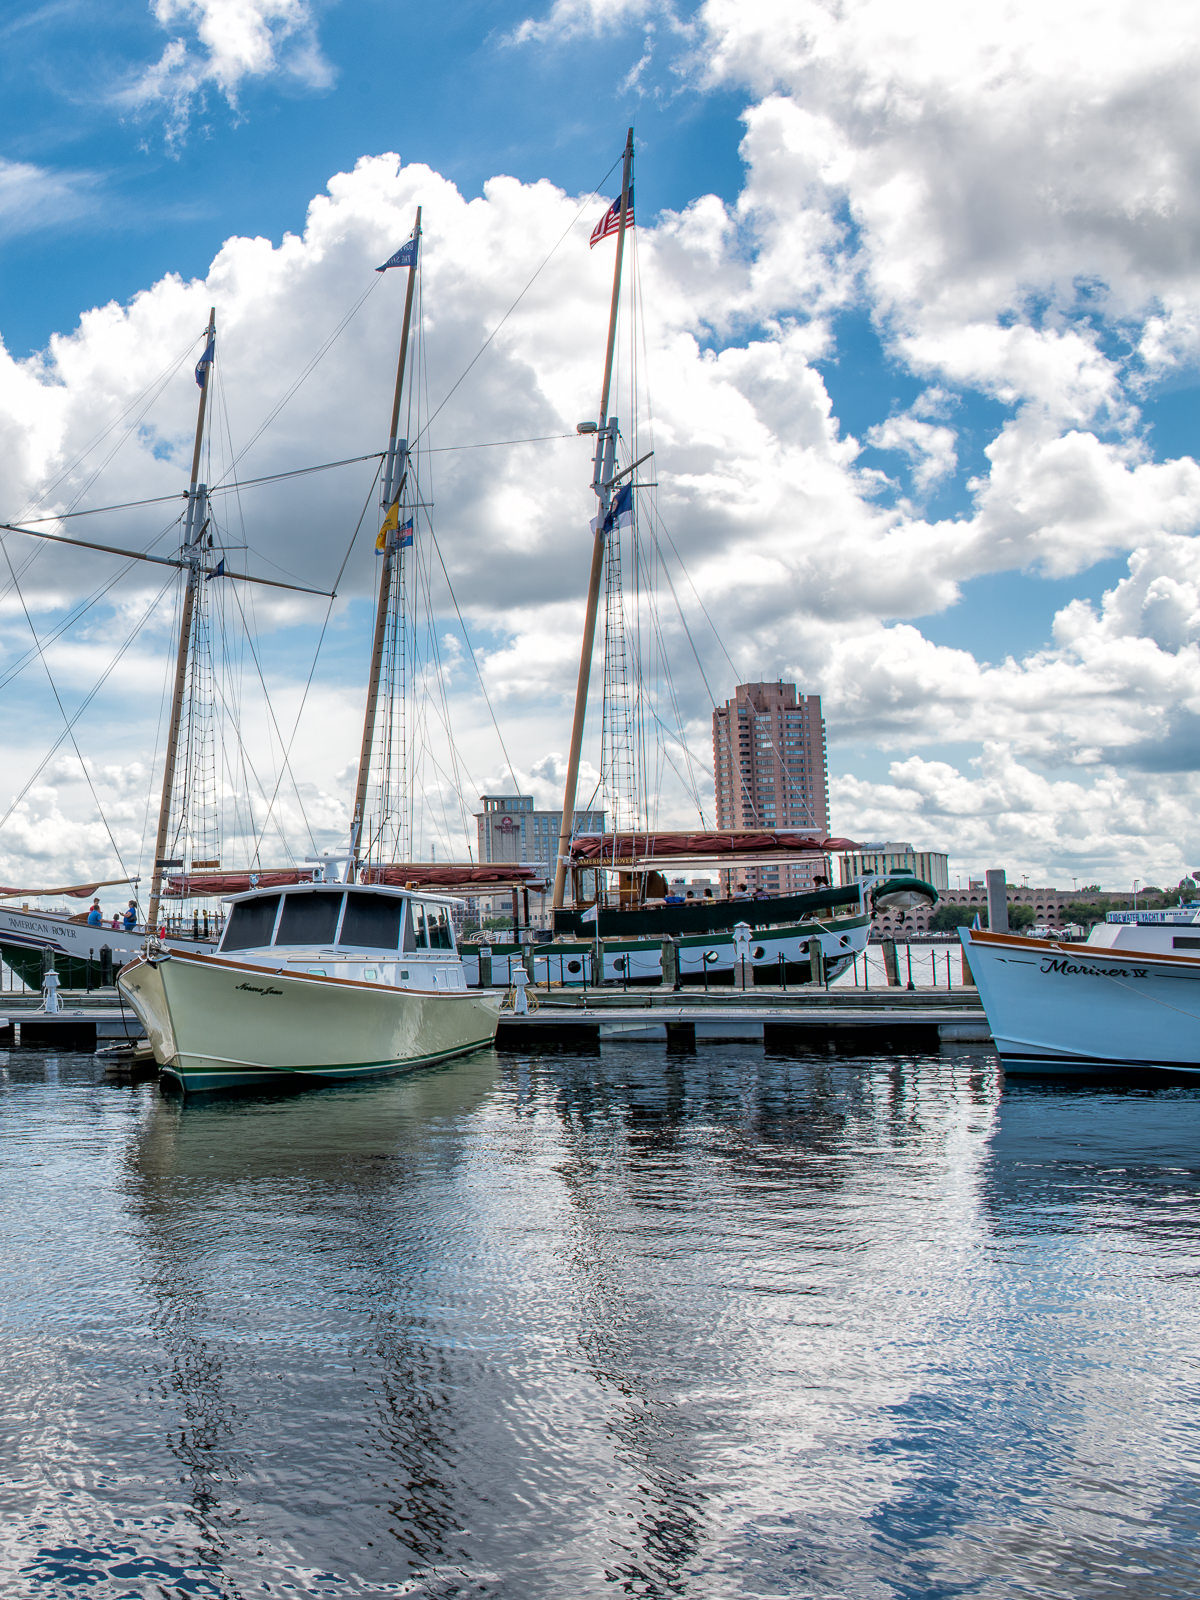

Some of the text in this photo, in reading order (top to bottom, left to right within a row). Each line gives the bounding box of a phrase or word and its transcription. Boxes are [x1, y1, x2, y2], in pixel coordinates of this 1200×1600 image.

[9, 918, 76, 938] AMERICAN ROVER
[1040, 957, 1131, 977] Mariner
